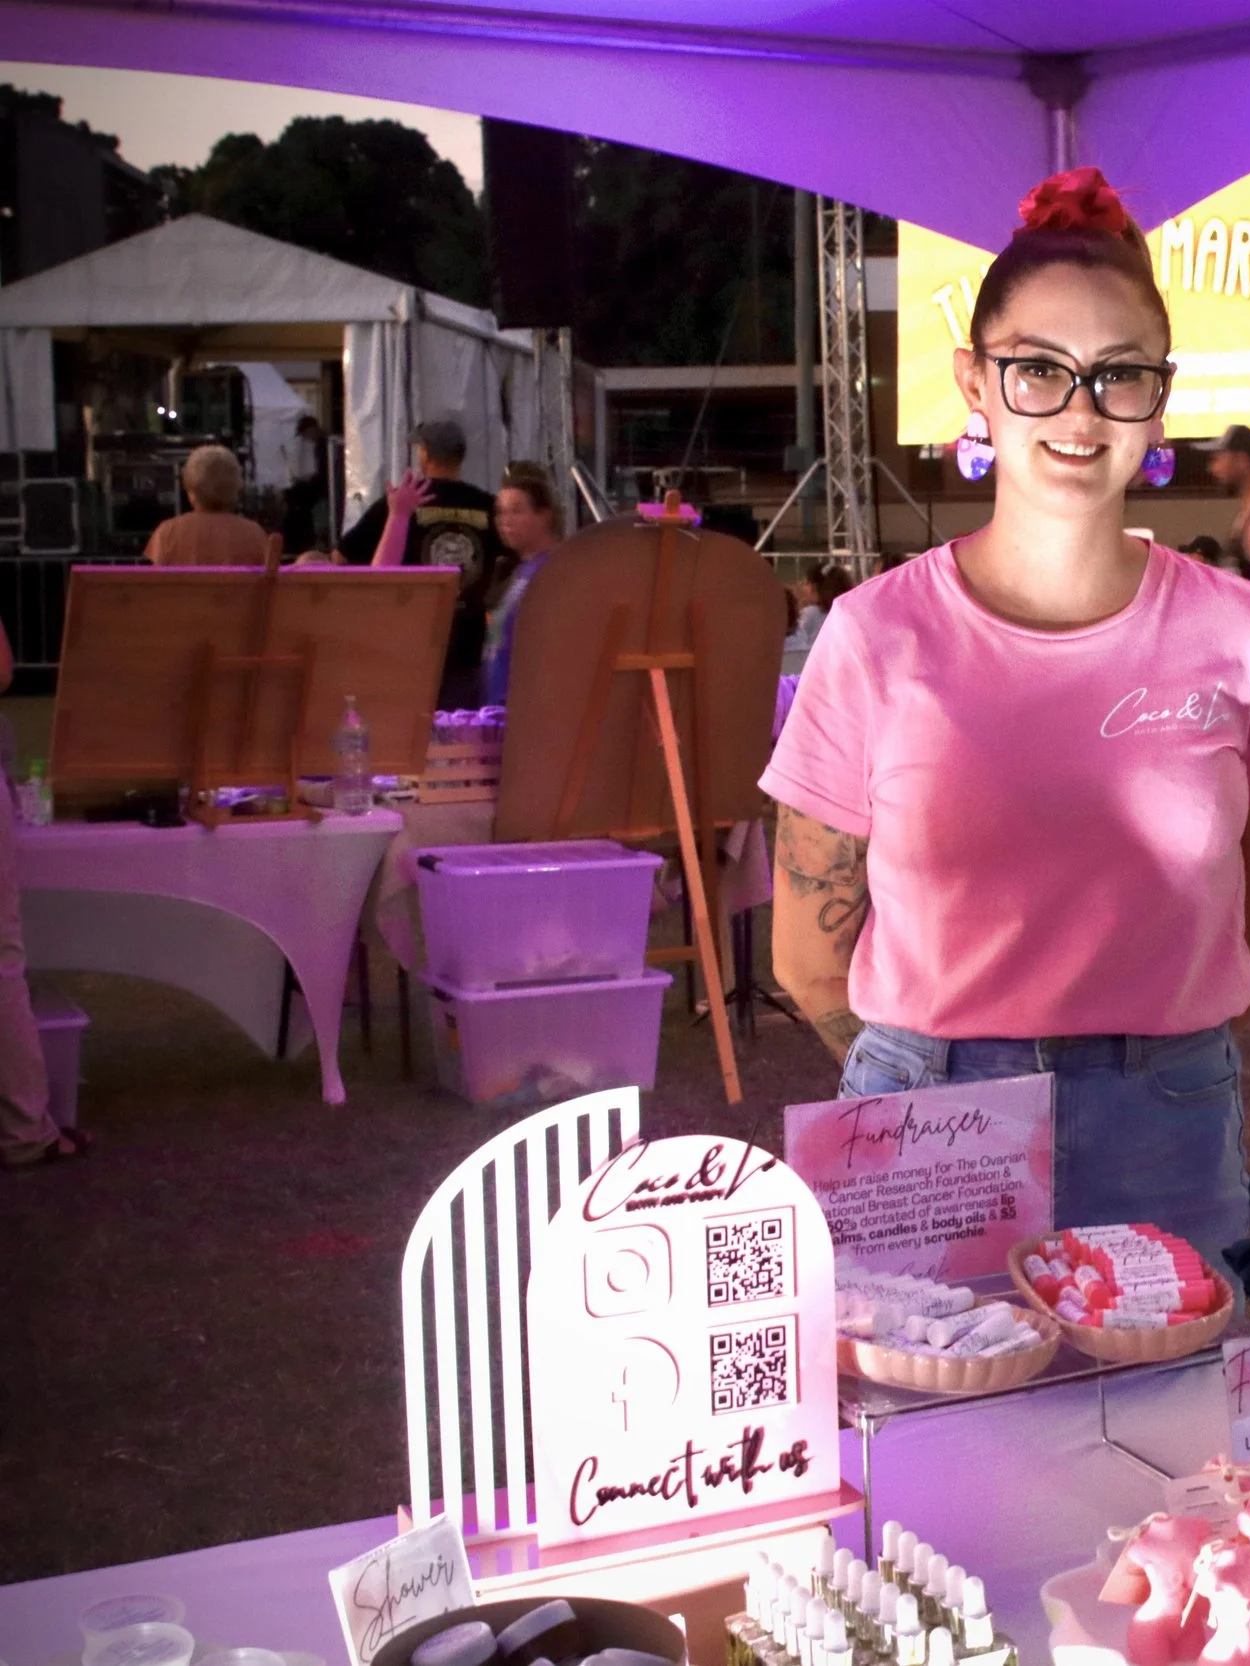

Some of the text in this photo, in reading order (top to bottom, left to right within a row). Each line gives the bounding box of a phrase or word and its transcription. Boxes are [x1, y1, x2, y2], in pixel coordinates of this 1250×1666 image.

[1100, 688, 1172, 738] Coco
[1176, 693, 1202, 720] &
[582, 1137, 680, 1222] Coco
[684, 1143, 727, 1190] &
[813, 1151, 1026, 1193] Help us raise money for The Ovarian
[829, 1166, 1012, 1204] Cancer Research Foundation &
[822, 1202, 866, 1220] ational
[868, 1194, 908, 1212] Breast
[911, 1189, 955, 1206] Cancer
[860, 1207, 916, 1228] dontated
[918, 1203, 931, 1217] of
[934, 1199, 998, 1216] awareness
[1001, 1193, 1016, 1207] lip
[832, 1205, 1017, 1247] alms, candles & body oils & $5
[887, 1236, 921, 1253] every
[570, 1424, 816, 1526] Connect with us
[354, 1553, 454, 1664] Shower
